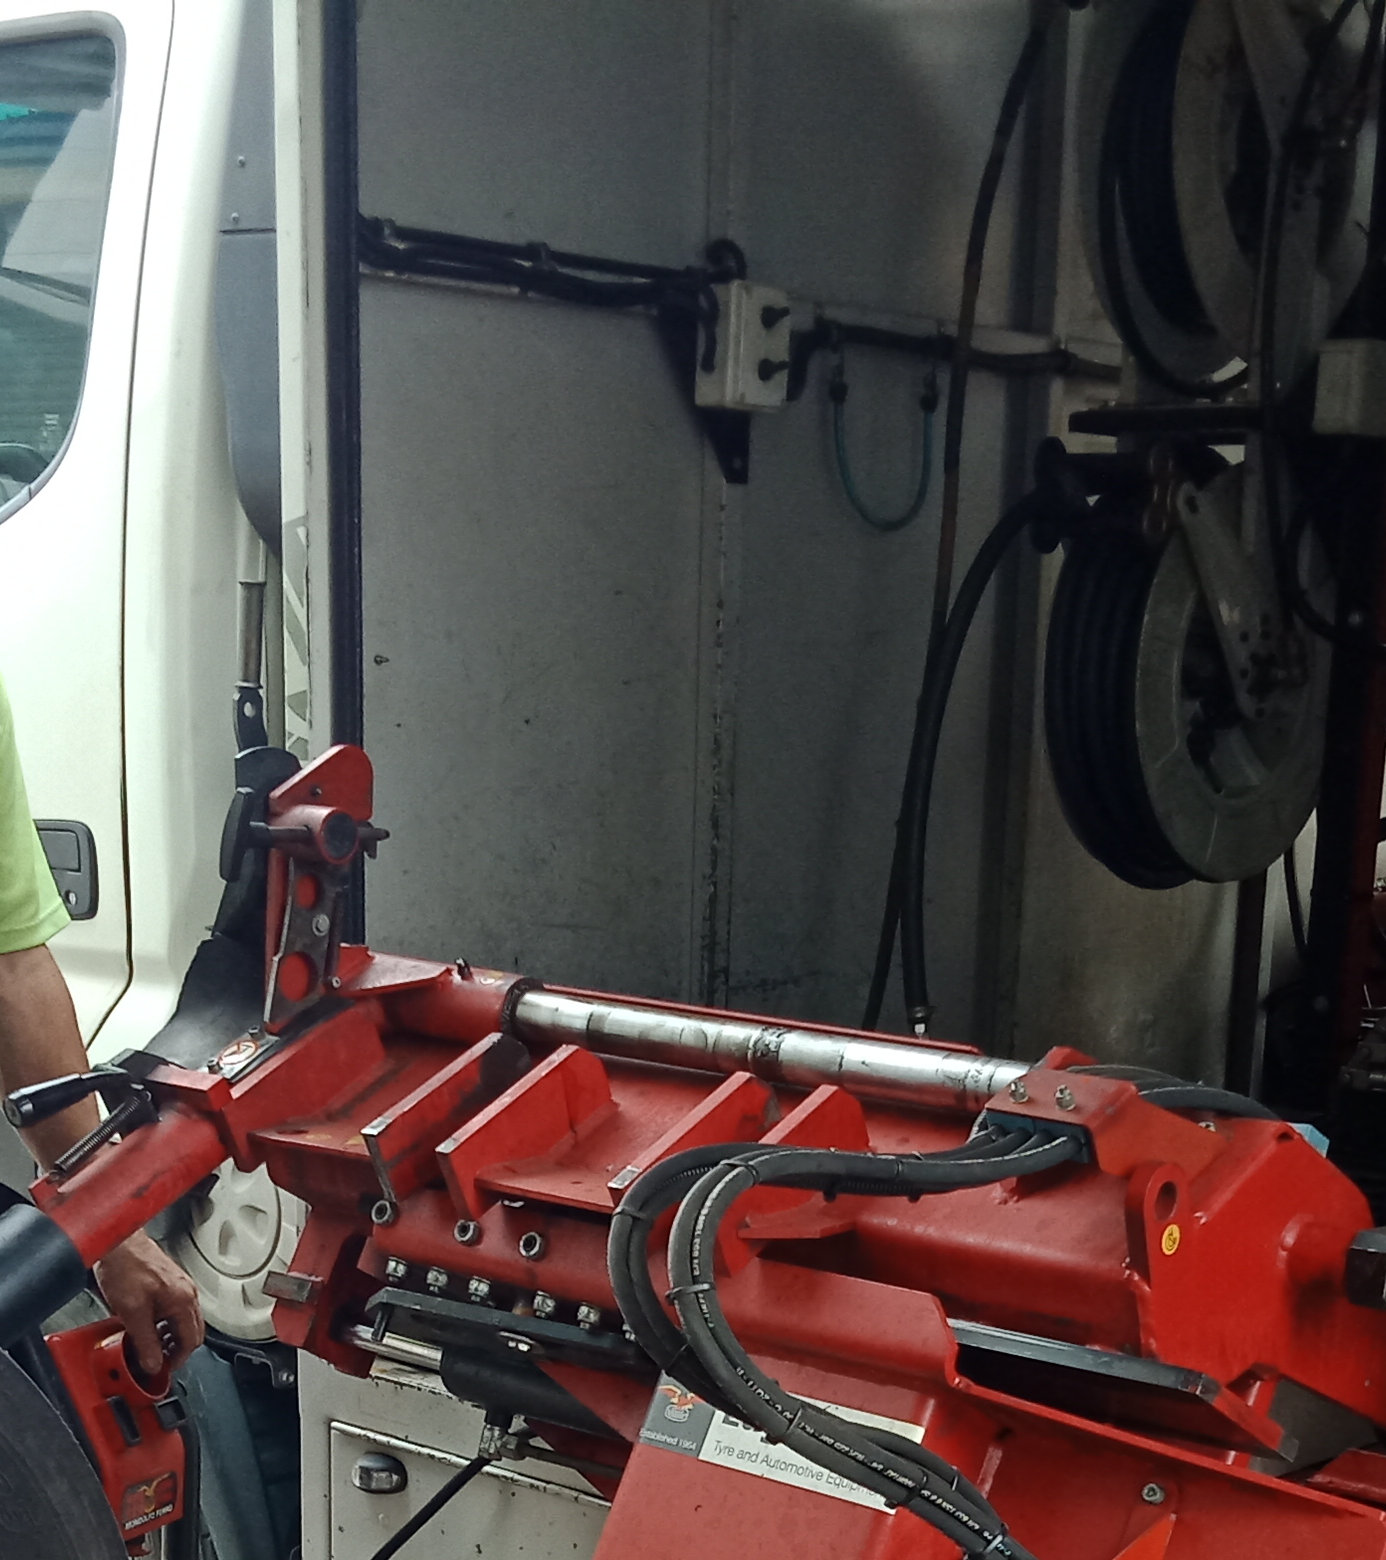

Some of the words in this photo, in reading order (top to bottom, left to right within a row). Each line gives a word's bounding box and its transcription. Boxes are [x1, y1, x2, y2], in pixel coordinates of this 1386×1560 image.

[714, 1440, 734, 1458] Tyre
[736, 1446, 759, 1464] and
[762, 1454, 824, 1481] Automotive
